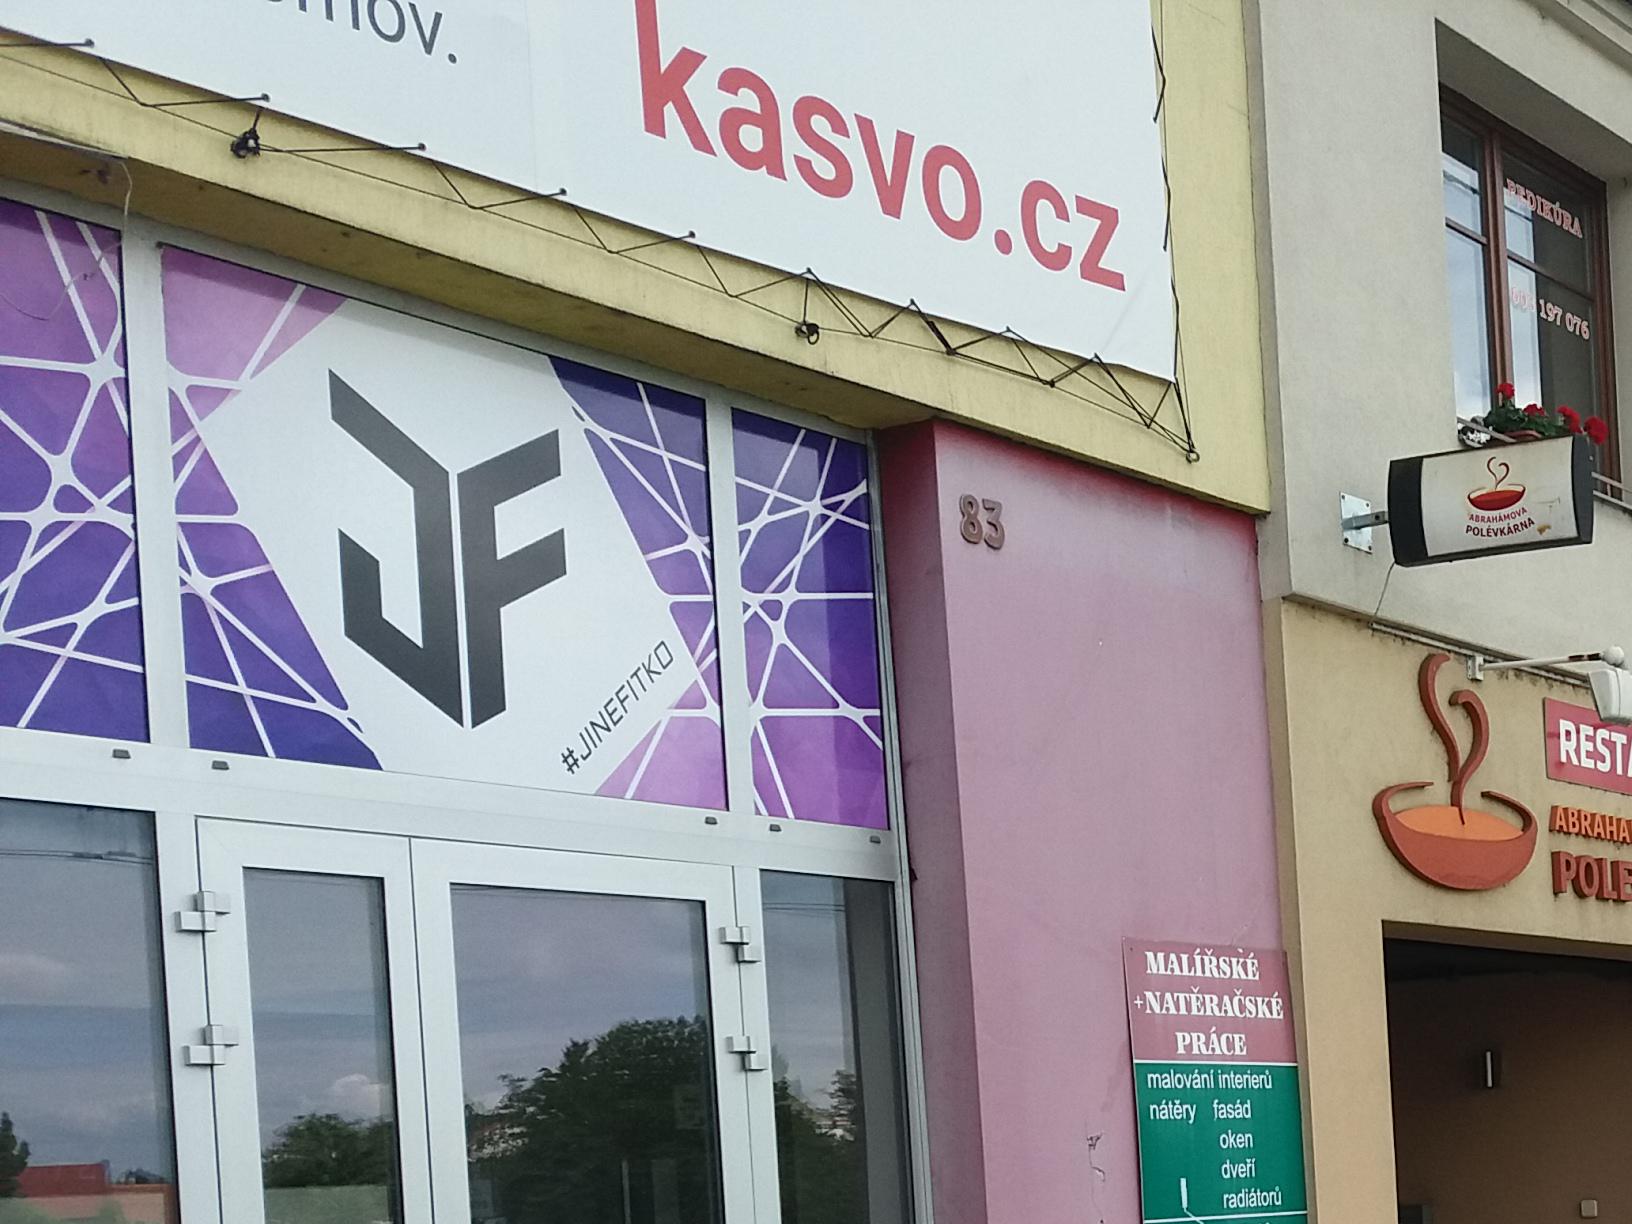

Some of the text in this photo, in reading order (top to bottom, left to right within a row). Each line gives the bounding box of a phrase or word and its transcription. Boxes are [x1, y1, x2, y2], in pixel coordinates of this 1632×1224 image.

[265, 0, 457, 64] ov.
[635, 0, 1126, 292] kasvo.cz
[1506, 178, 1583, 239] PEDIKÚRA
[1539, 298, 1563, 327] 197
[1565, 312, 1590, 340] 076
[959, 494, 1006, 551] 83
[1465, 516, 1535, 538] POLÉVKÁRNA
[561, 640, 674, 775] #JINEFITKO
[1145, 948, 1260, 981] MALÍŘSKÉ
[1175, 1026, 1247, 1056] PRÁCE
[1147, 1069, 1272, 1089] malování interierů
[1150, 1099, 1252, 1124] nátěry fasád
[1219, 1130, 1253, 1149] oken
[1221, 1158, 1256, 1179] dveří
[1223, 1186, 1282, 1209] radiátorů
